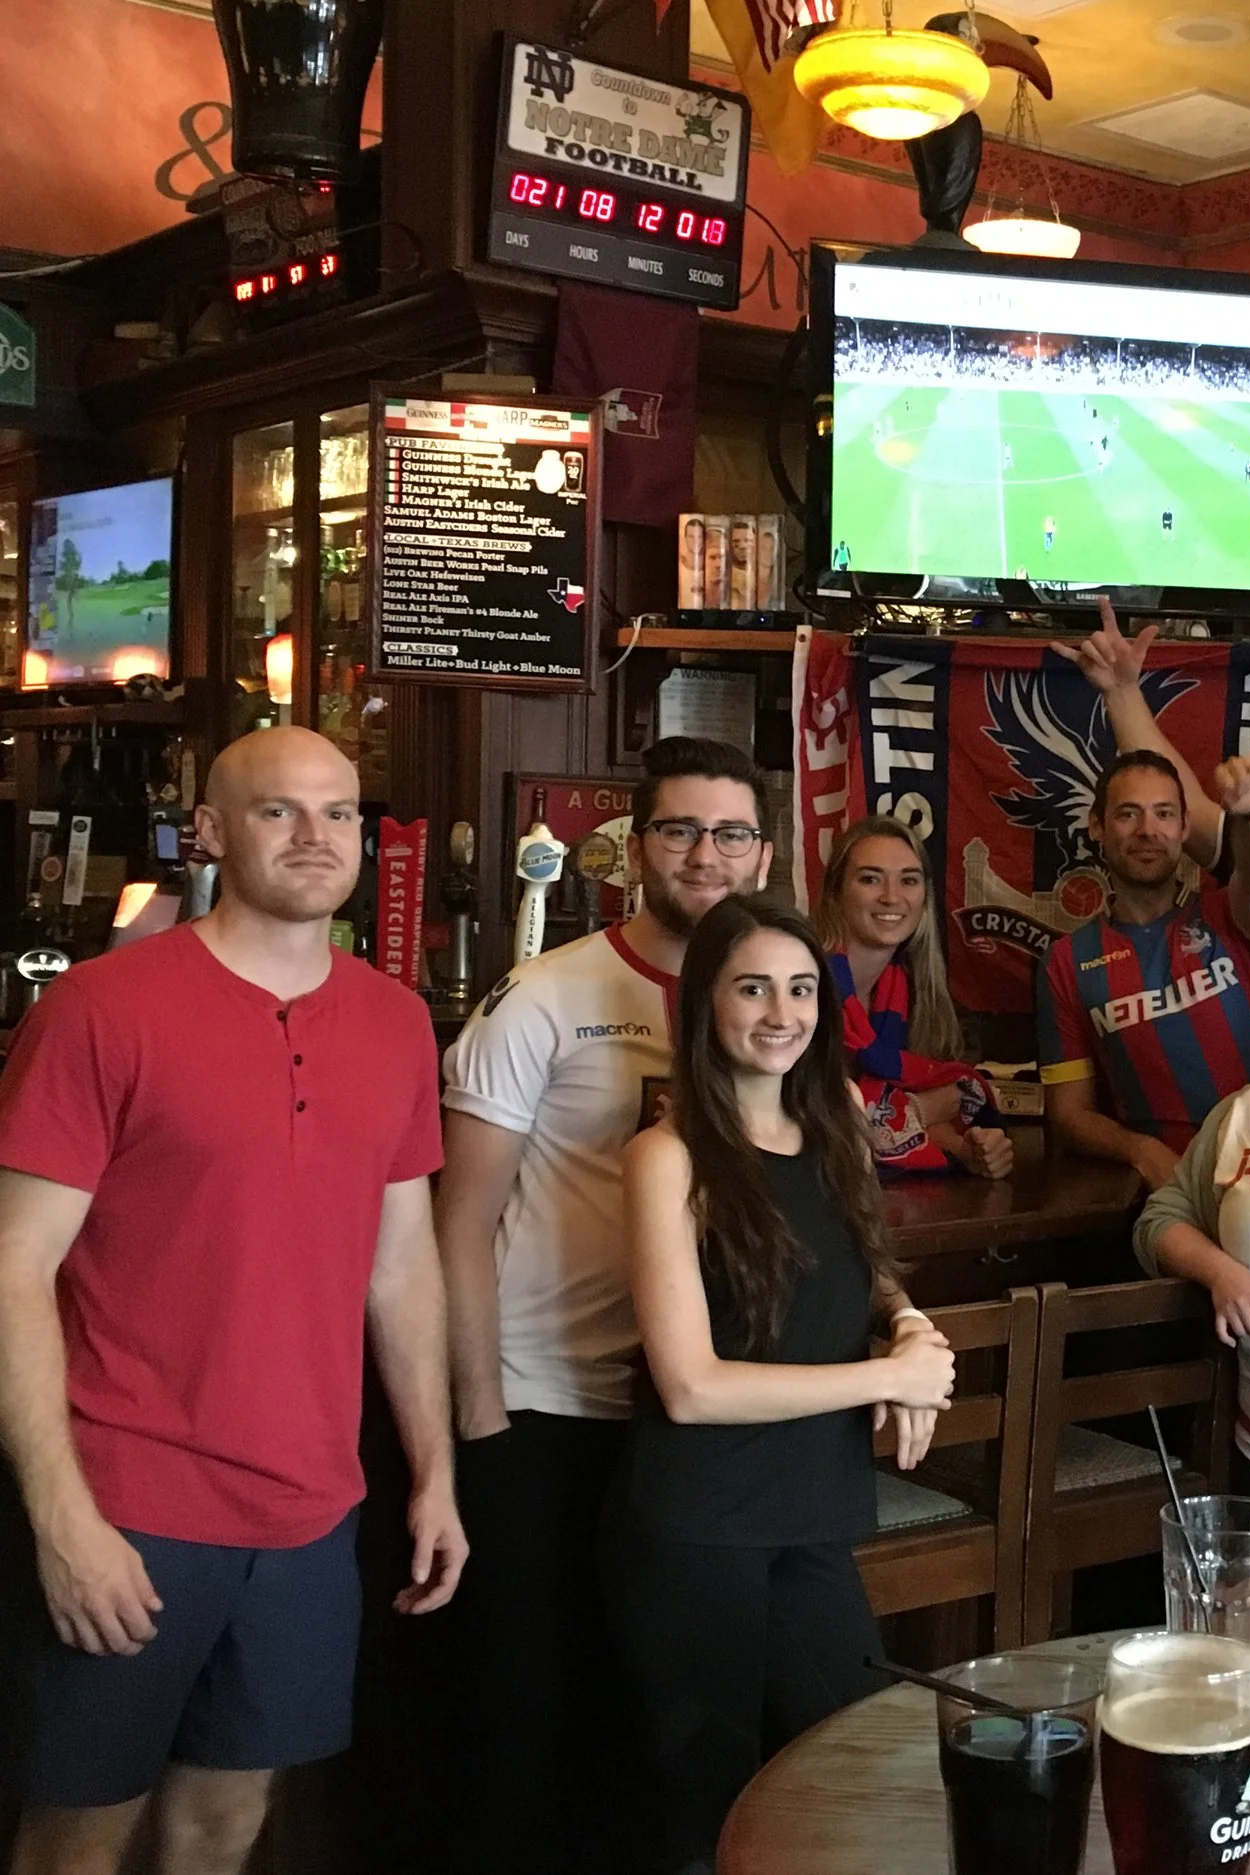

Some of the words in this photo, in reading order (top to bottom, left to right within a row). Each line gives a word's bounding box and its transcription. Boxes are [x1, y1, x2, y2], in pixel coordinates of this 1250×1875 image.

[591, 69, 672, 106] Countdown
[622, 97, 638, 116] to
[524, 99, 633, 154] NOTRE
[638, 128, 727, 177] DAME
[544, 137, 702, 191] FOOTBALL
[511, 174, 565, 209] 021
[579, 190, 616, 221] 08
[637, 204, 663, 231] 12
[505, 231, 529, 248] DAYS
[569, 244, 599, 263] HOURS
[627, 256, 663, 275] MINUTES
[688, 268, 724, 288] SECONDS
[406, 407, 448, 420] GUINNESS
[530, 420, 568, 429] MAGNERS
[389, 438, 417, 448] PUB
[402, 450, 462, 463] GUINNESS
[402, 462, 462, 475] GUINNESS
[402, 484, 435, 495] HARP
[438, 485, 469, 499] Lager
[511, 480, 530, 491] Ale
[465, 499, 491, 511] Irish
[494, 501, 525, 513] Cider
[384, 505, 431, 517] SAMUEL
[433, 508, 474, 521] ADAMS
[477, 512, 517, 523] Boston
[520, 514, 551, 528] Lager
[384, 517, 424, 529] AUSTIN
[426, 519, 488, 533] EASTCIDERS
[491, 523, 536, 536] Seasonal
[537, 527, 566, 538] Cider
[387, 534, 429, 544] LOCAL
[439, 537, 479, 547] TEXAS
[483, 540, 527, 551] BREWS
[404, 546, 444, 557] BREWING
[446, 549, 474, 559] Pecan
[476, 551, 505, 561] Porter
[384, 556, 418, 567] AUSTIN
[421, 558, 444, 568] BEER
[447, 560, 479, 570] WORKS
[482, 562, 504, 572] Pearl
[506, 564, 529, 576] Snap
[531, 565, 548, 575] Pils
[384, 568, 405, 577] LIVE
[408, 569, 428, 578] OAK
[430, 570, 485, 582] Hefeweizen
[383, 579, 408, 589] LONE
[411, 581, 435, 590] STAR
[437, 582, 458, 592] Beer
[383, 590, 407, 600] REAL
[429, 593, 450, 603] Axis
[452, 595, 469, 604] IPA
[382, 613, 418, 623] SHINER
[420, 615, 444, 625] Bock
[383, 602, 407, 612] REAL
[429, 605, 474, 615] Fireman's
[489, 608, 521, 618] Blonde
[522, 610, 538, 619] Ale
[382, 624, 422, 635] THIRSTY
[424, 626, 460, 637] PLANET
[461, 628, 495, 641] Thirsty
[497, 630, 519, 640] Goat
[520, 632, 551, 642] Amber
[387, 643, 454, 655] CLASSICS
[387, 655, 423, 667] Miller
[425, 656, 447, 668] Lite
[456, 659, 479, 670] Bud
[482, 660, 511, 673] Light
[520, 662, 545, 673] Blue
[548, 665, 581, 675] Moon
[868, 655, 936, 842] STIN
[567, 790, 583, 809] A
[417, 838, 428, 873] RUBY
[521, 853, 541, 869] BLUE
[541, 851, 562, 865] MOON
[1080, 949, 1131, 971] macron
[1089, 957, 1239, 1038] NETELLER
[575, 1022, 651, 1039] macron
